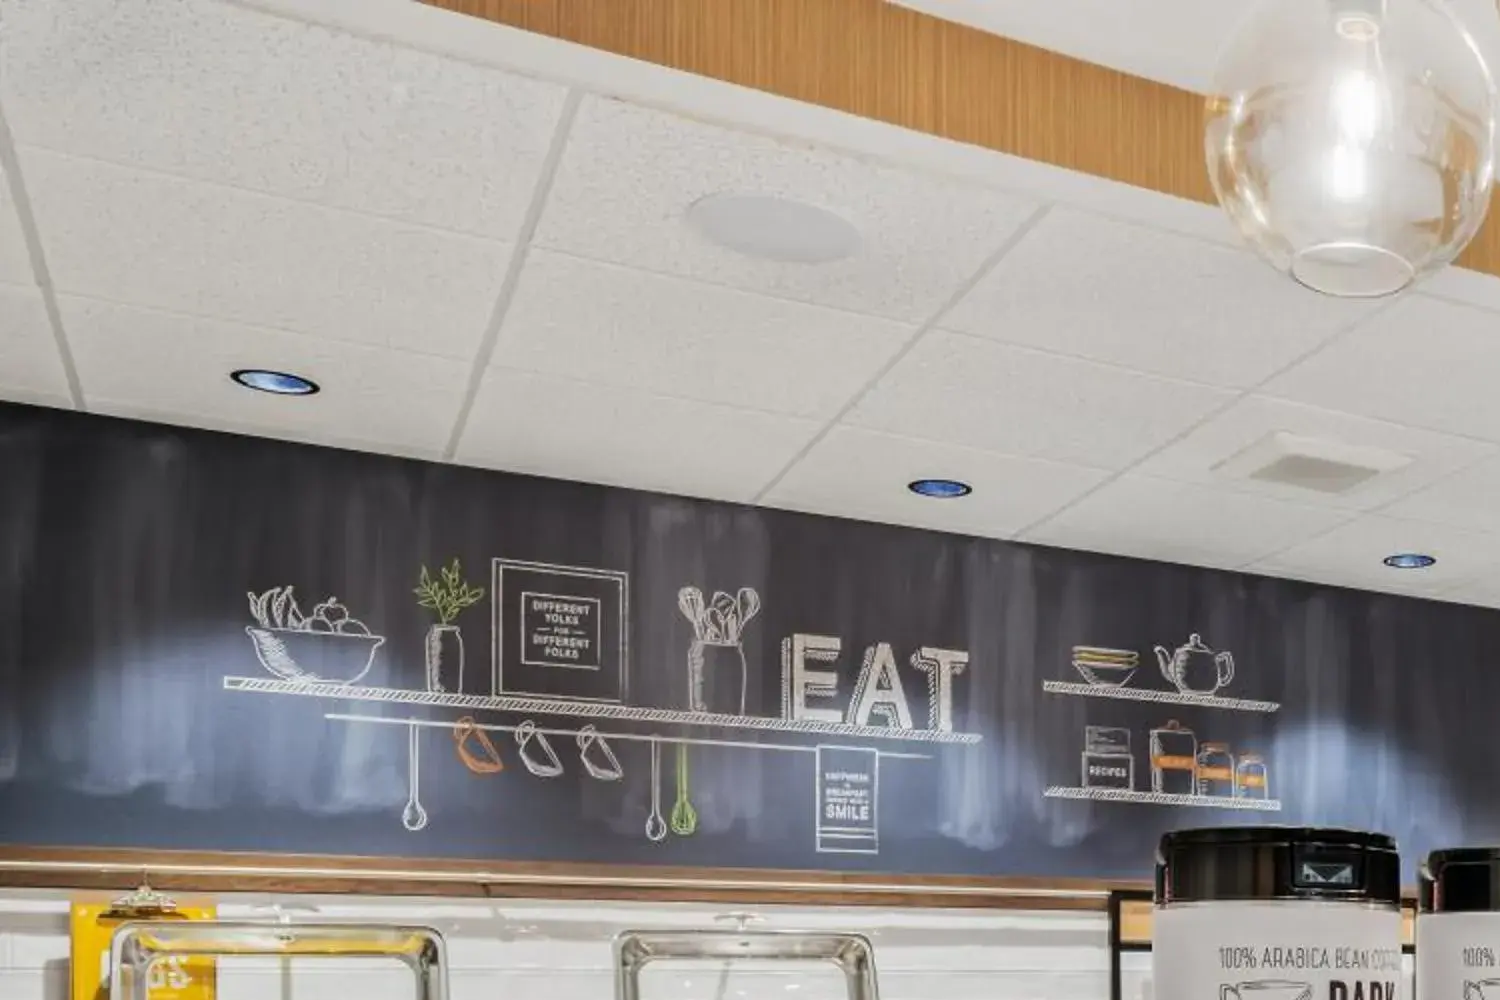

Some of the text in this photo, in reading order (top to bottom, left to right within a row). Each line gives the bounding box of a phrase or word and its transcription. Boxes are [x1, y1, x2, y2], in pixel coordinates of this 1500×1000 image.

[533, 600, 590, 615] DIFFERENT
[545, 613, 579, 625] YOLKS
[532, 633, 591, 649] DIFFERENT
[781, 633, 969, 733] EAT
[1089, 765, 1127, 778] RECIPES
[826, 804, 869, 820] SMILE
[1219, 947, 1257, 968] 100%
[1261, 947, 1330, 969] ARABICA
[1335, 948, 1369, 969] BEAN
[1463, 947, 1495, 967] 100%
